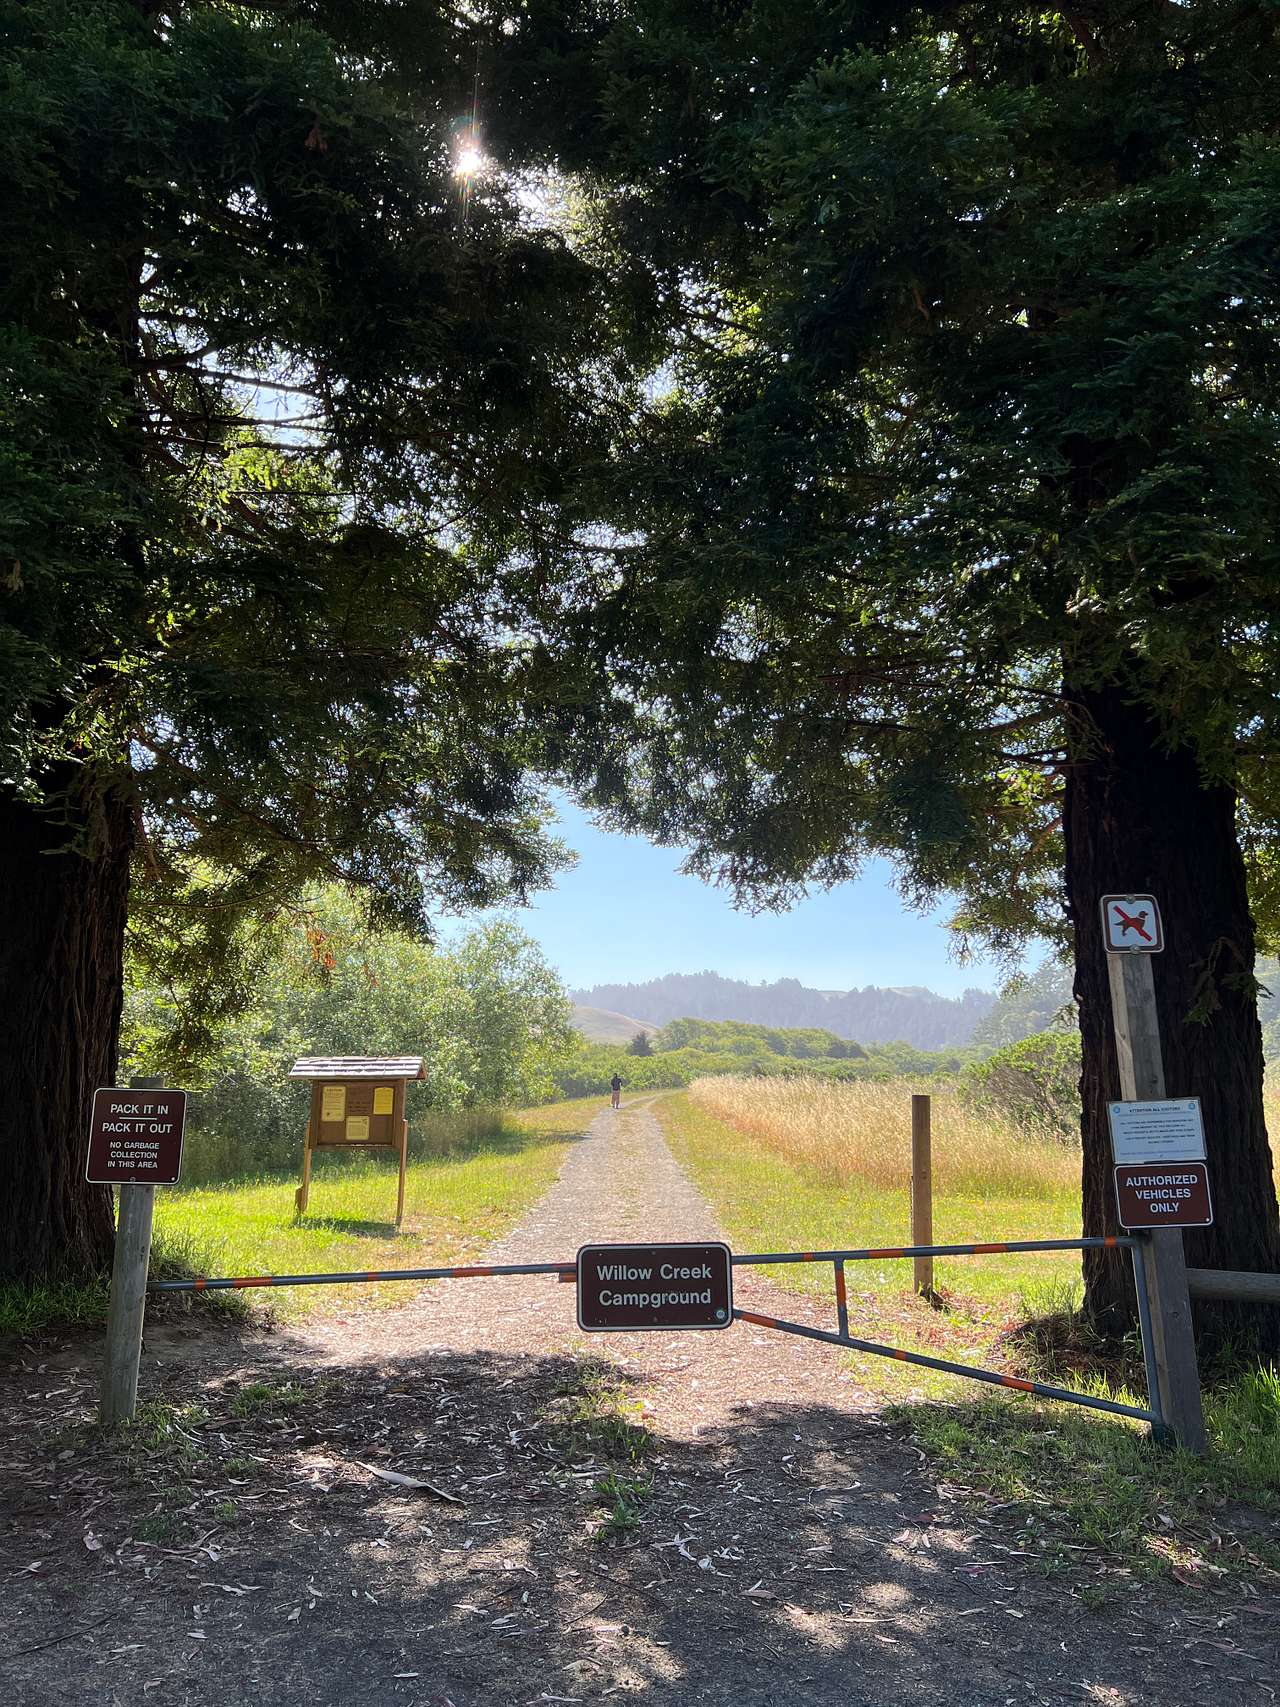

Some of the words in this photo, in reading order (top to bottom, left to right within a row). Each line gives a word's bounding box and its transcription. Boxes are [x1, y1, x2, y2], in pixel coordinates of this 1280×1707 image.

[110, 1104, 139, 1114] PACK
[143, 1104, 154, 1114] IT
[157, 1105, 169, 1115] IN
[102, 1122, 131, 1133] PACK
[135, 1123, 146, 1133] IT
[149, 1123, 173, 1134] OUT
[109, 1141, 122, 1149] NO
[123, 1141, 160, 1150] GARBAGE
[110, 1151, 158, 1159] COLLECTION
[107, 1160, 116, 1168] IN
[118, 1160, 135, 1168] THIS
[137, 1161, 158, 1169] AREA
[1126, 1174, 1198, 1187] AUTHORIZED
[1135, 1188, 1191, 1200] VEHICLES
[1150, 1202, 1179, 1213] ONLY
[596, 1264, 652, 1281] Willow
[659, 1263, 713, 1280] Creek
[599, 1288, 711, 1309] Campground
